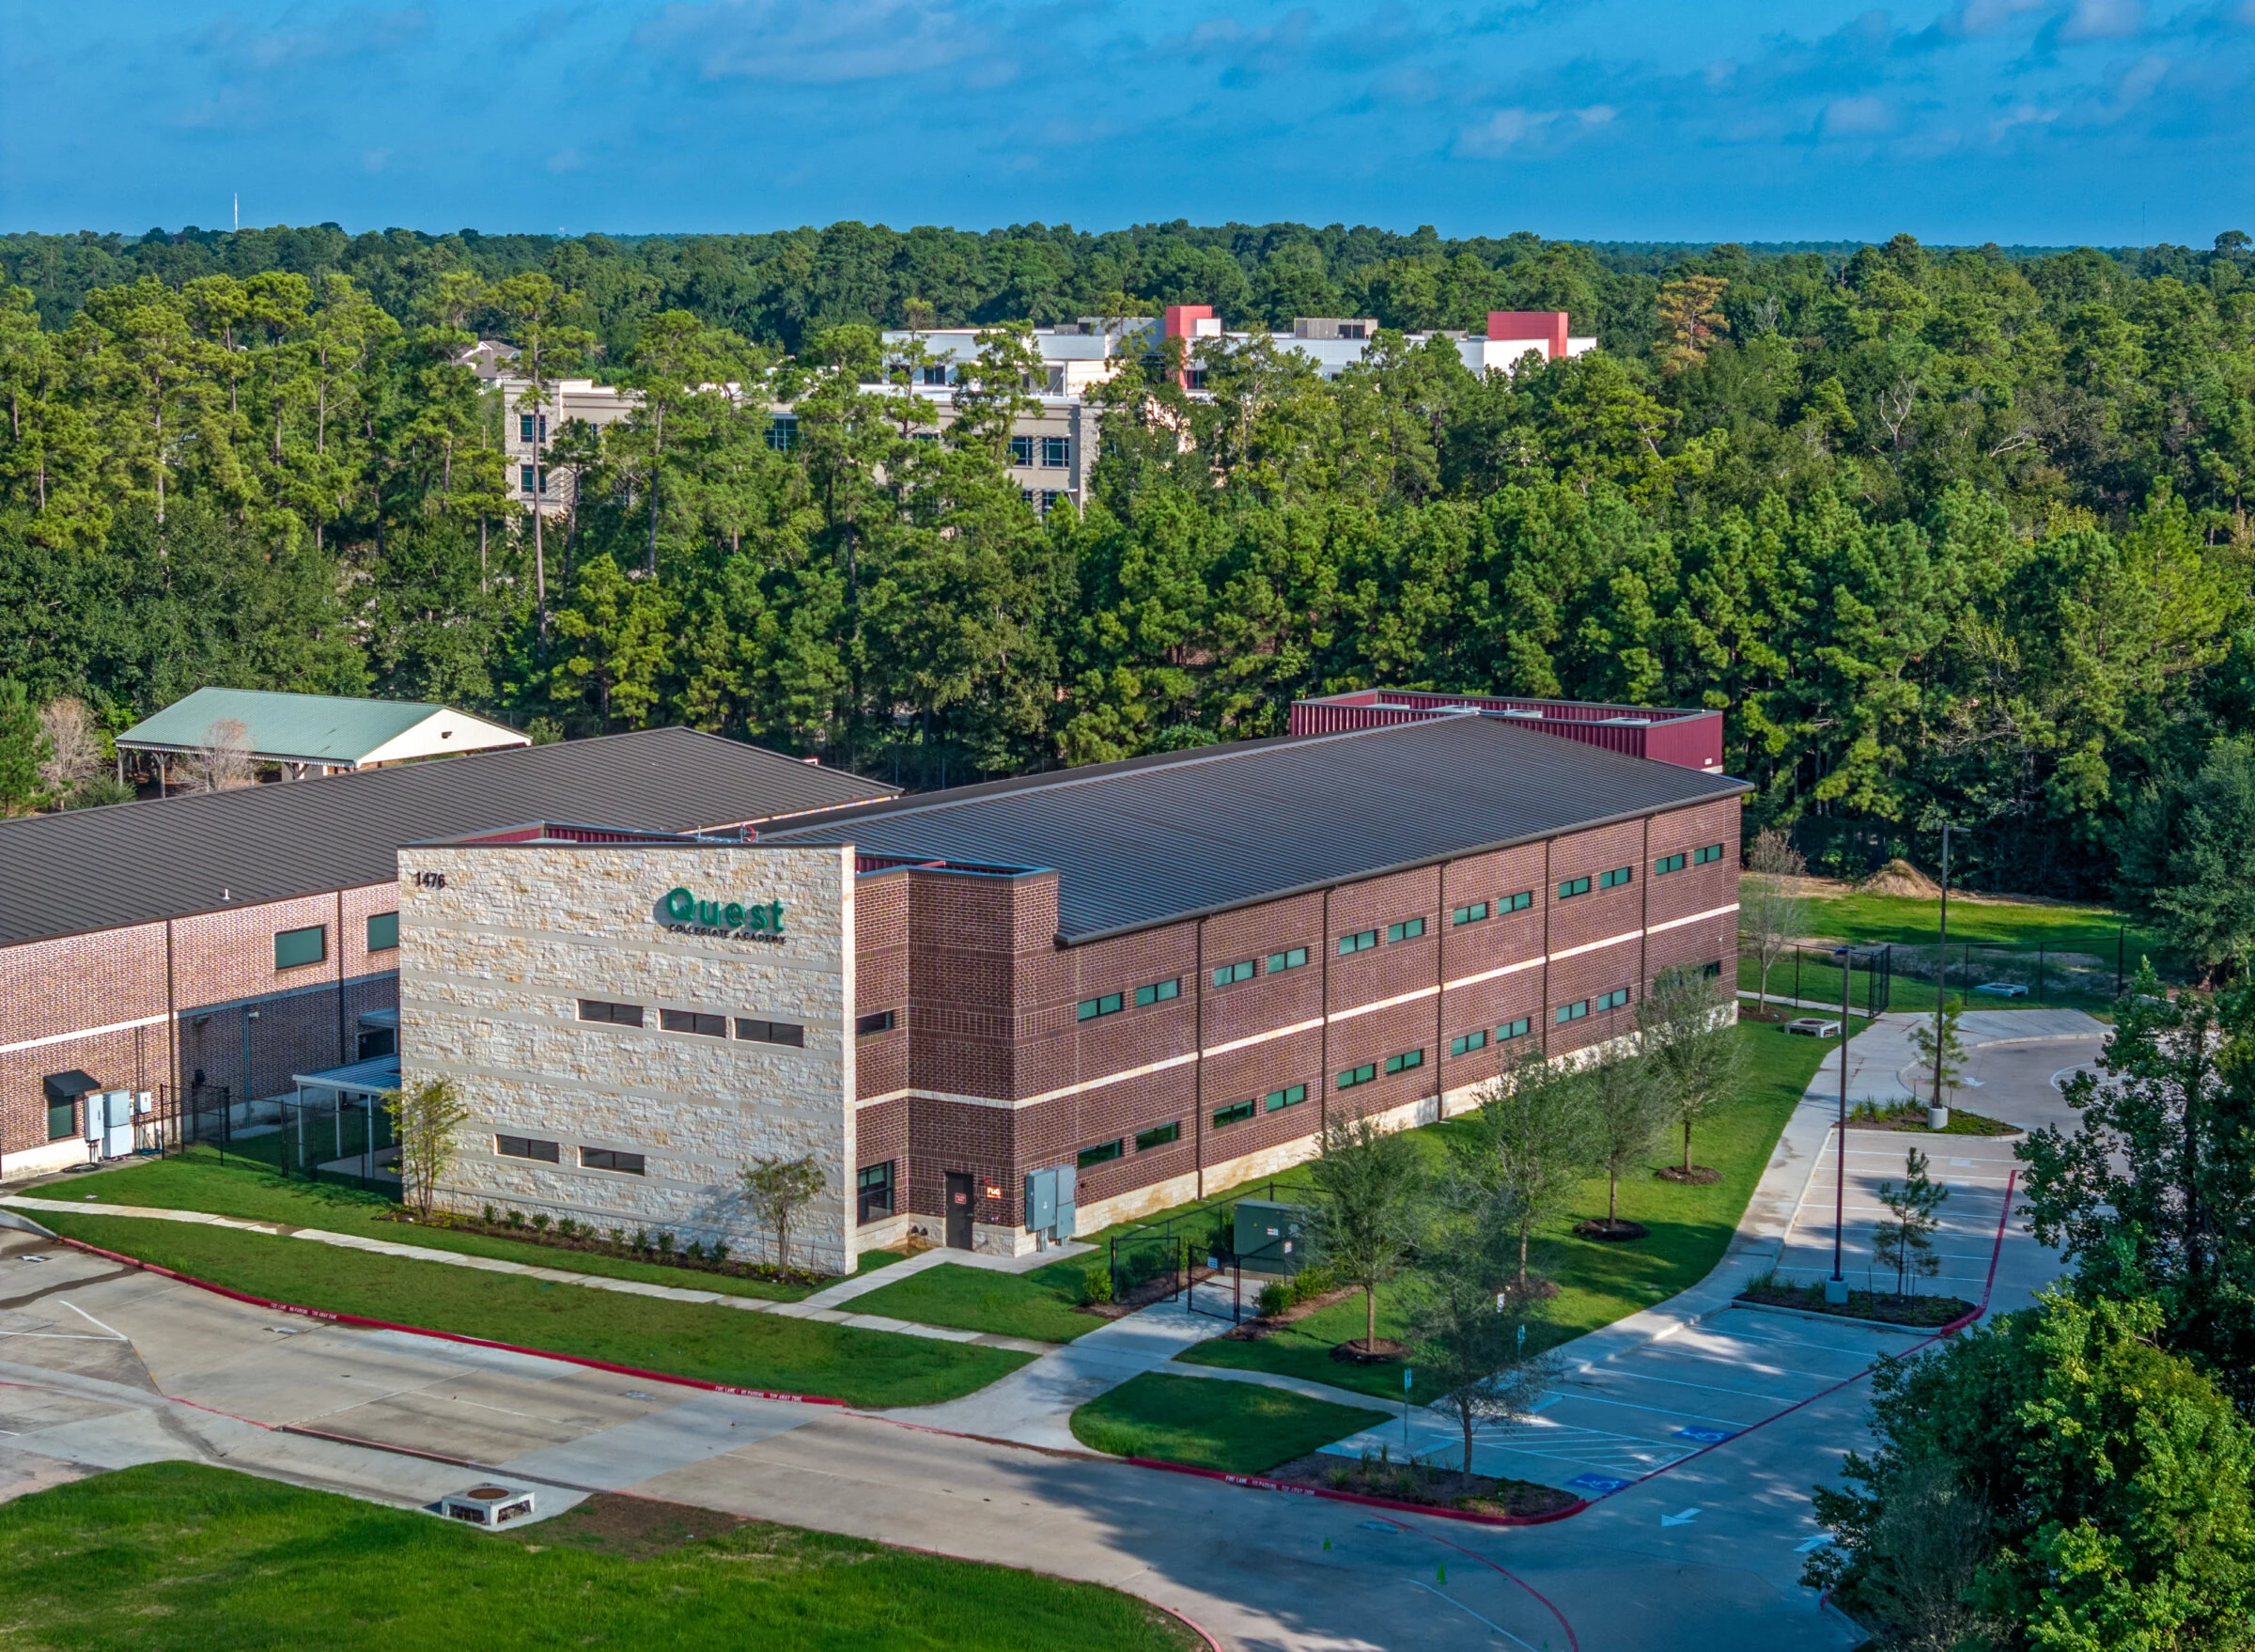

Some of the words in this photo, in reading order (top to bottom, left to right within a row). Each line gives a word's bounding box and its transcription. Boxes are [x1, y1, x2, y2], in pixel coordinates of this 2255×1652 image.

[415, 872, 445, 888] 1476
[667, 887, 785, 932] Quest
[669, 924, 729, 939] COLLEGIATE
[732, 931, 786, 944] ACADEMY
